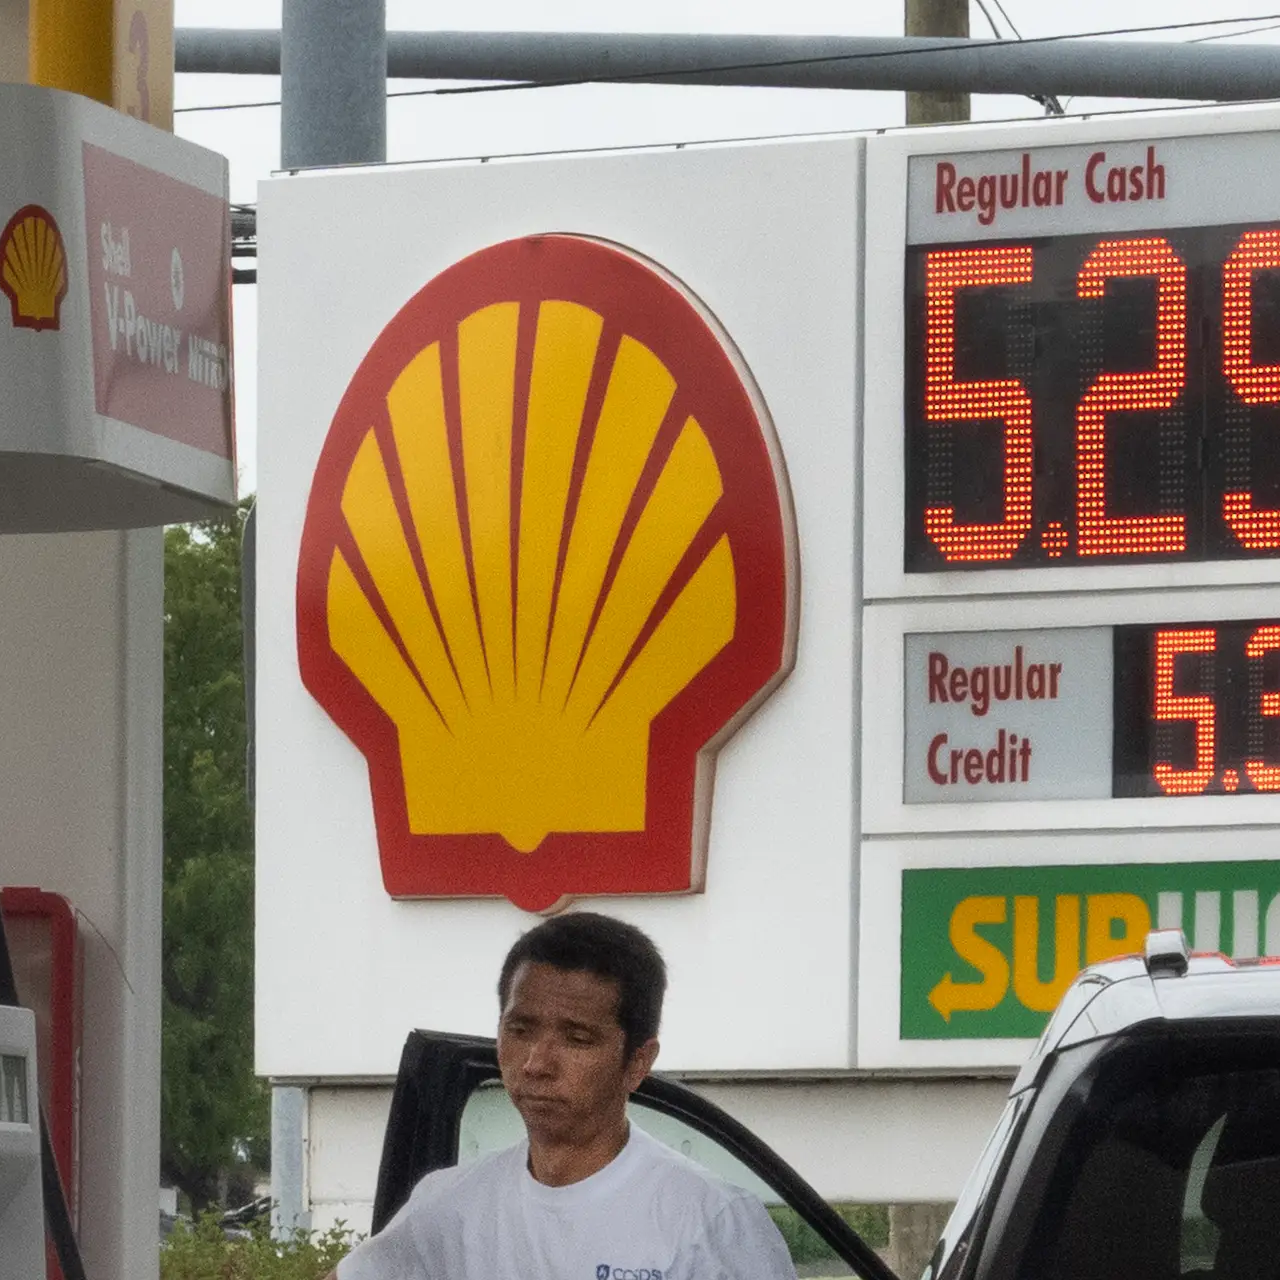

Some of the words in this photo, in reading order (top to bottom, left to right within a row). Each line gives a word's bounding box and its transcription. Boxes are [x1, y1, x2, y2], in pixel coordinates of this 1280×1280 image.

[936, 154, 1068, 226] Regular
[1085, 145, 1166, 203] Cash
[101, 219, 131, 278] Shell
[104, 282, 181, 375] V-Power
[928, 646, 1062, 716] Regular
[927, 729, 1032, 786] Credit
